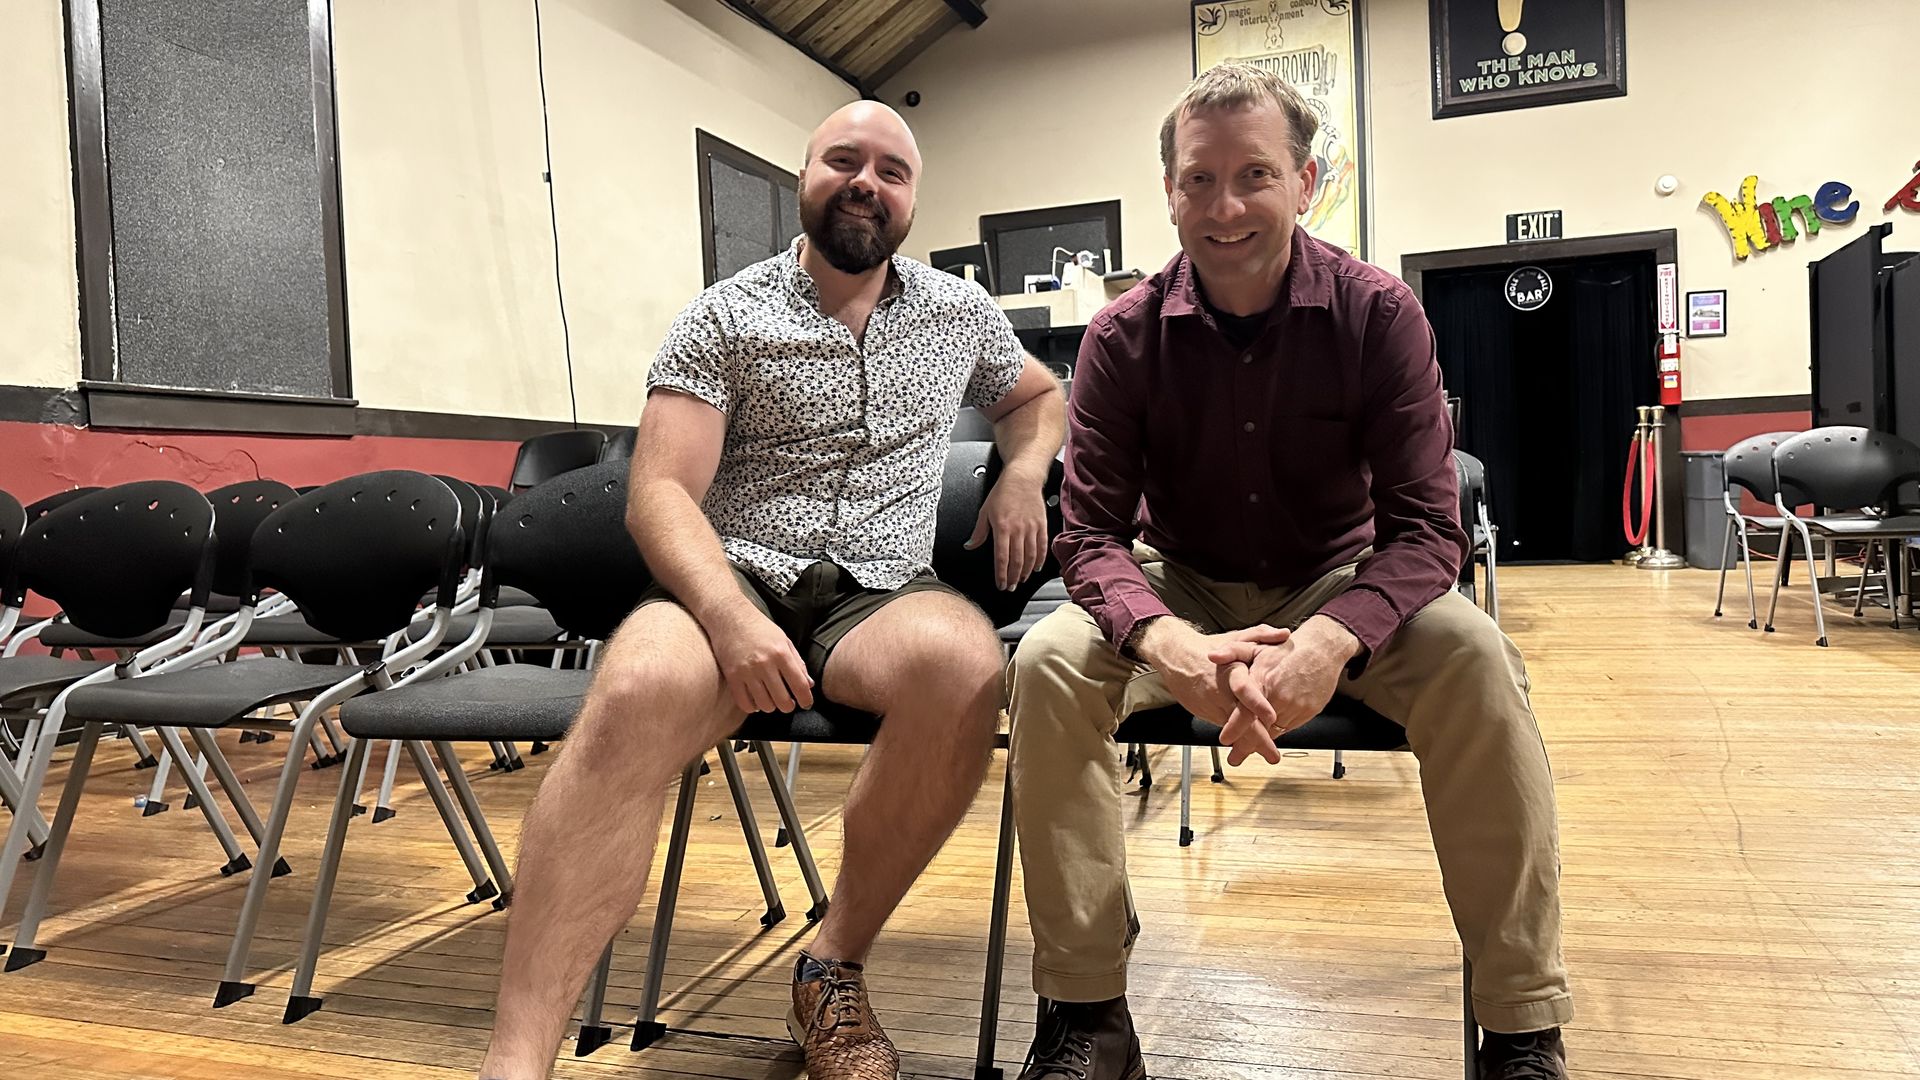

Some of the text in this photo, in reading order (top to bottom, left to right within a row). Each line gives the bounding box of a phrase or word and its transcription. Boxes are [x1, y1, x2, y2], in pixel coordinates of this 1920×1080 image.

[1228, 6, 1251, 19] magic
[1477, 49, 1576, 75] THE MAN
[1458, 62, 1598, 93] WHO KNOWS
[1517, 213, 1553, 240] EXIT
[1516, 289, 1543, 303] BAR
